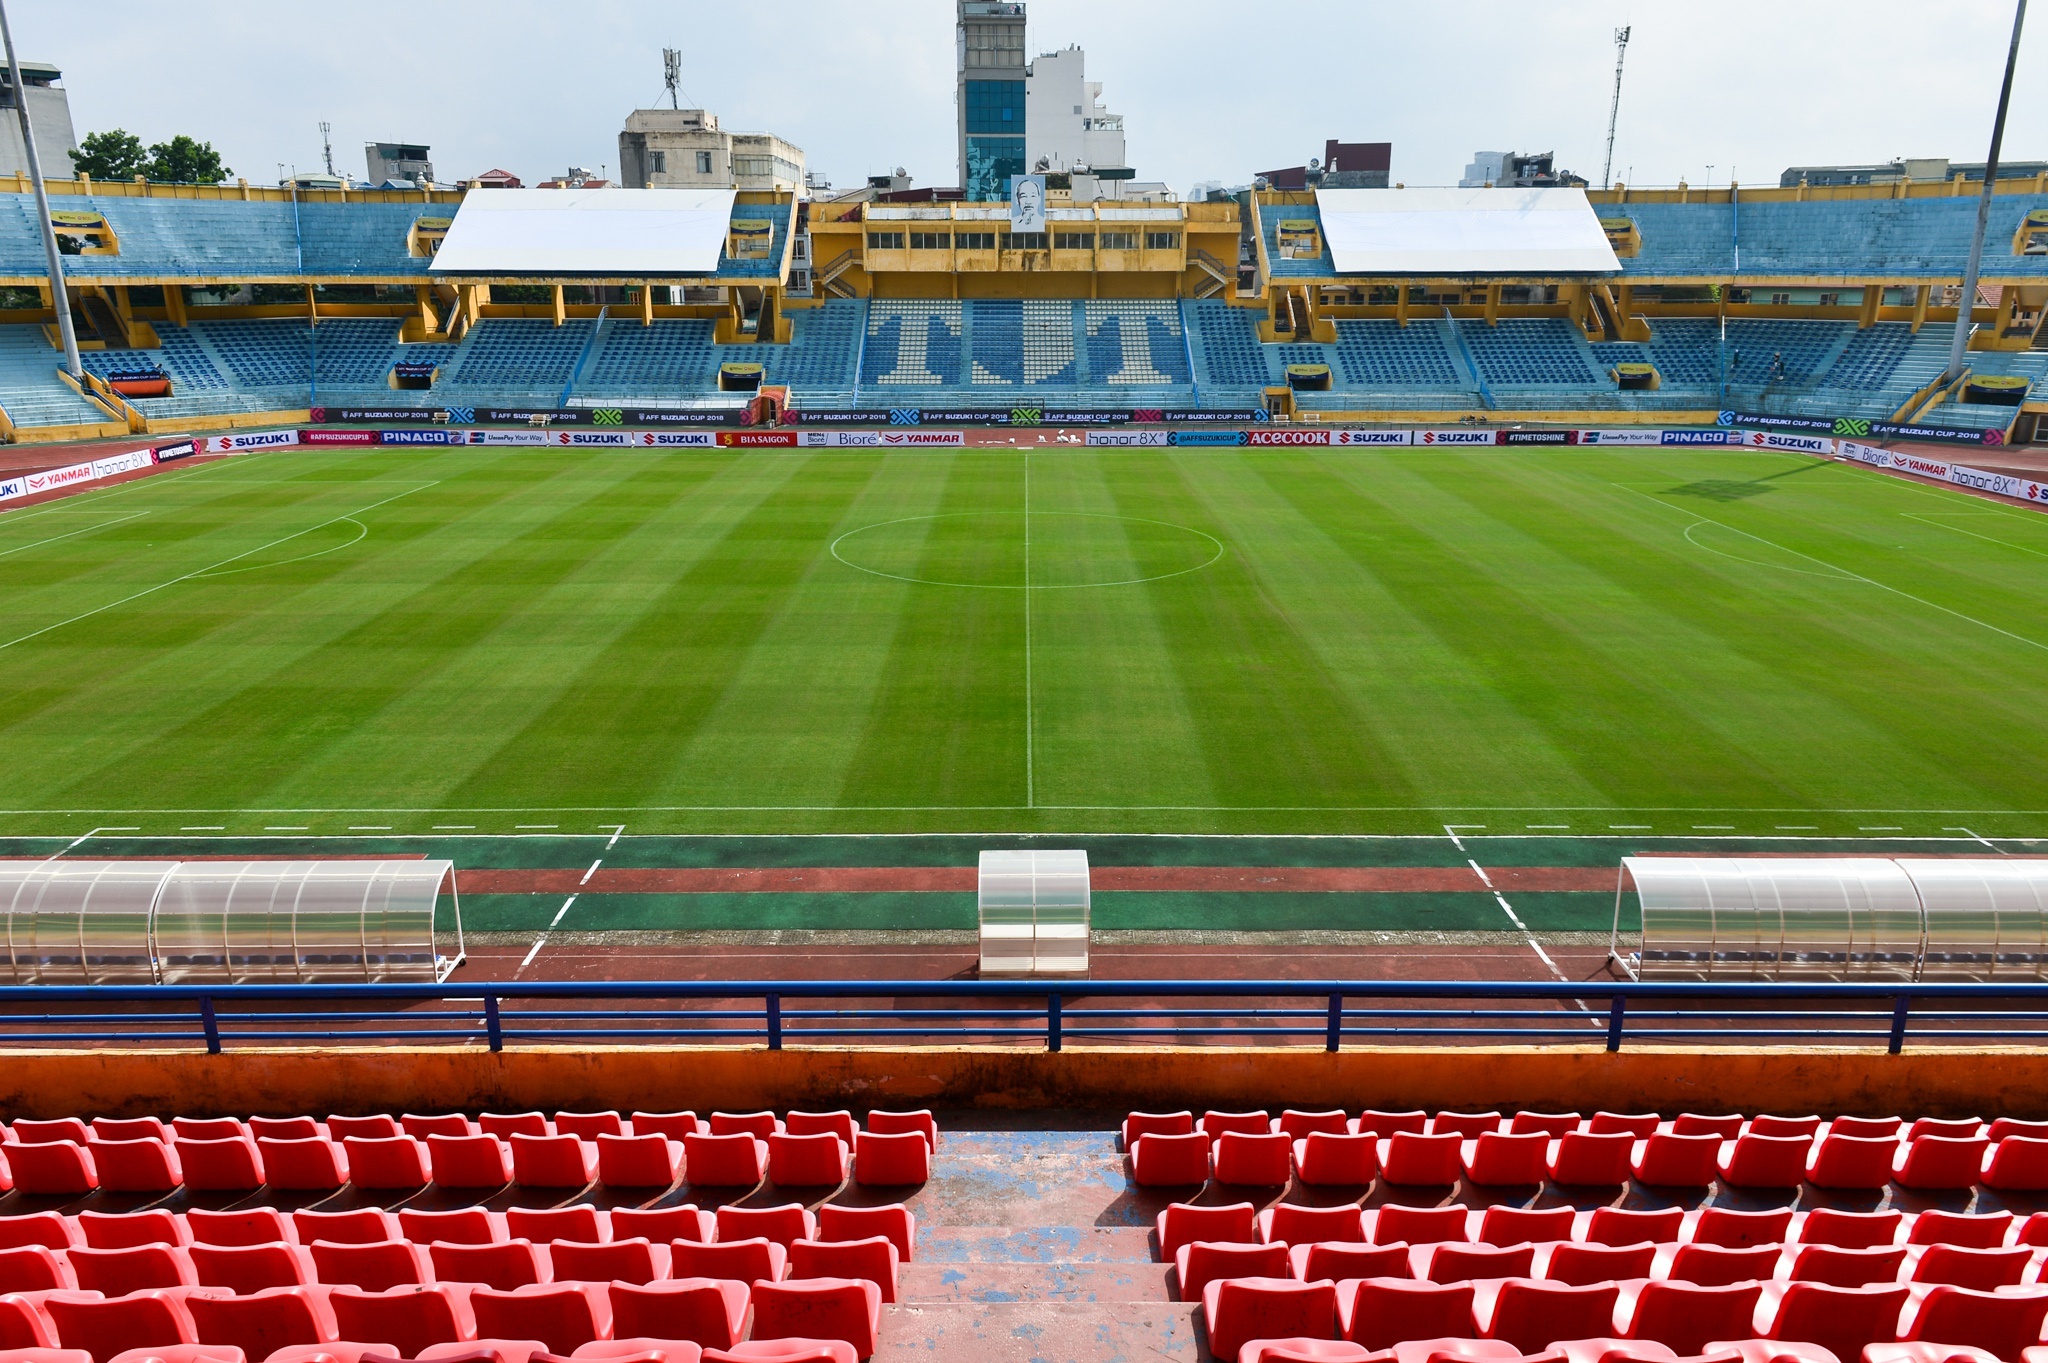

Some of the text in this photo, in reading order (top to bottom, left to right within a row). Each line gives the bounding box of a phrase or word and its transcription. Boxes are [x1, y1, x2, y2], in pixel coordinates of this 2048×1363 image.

[236, 434, 290, 446] SUZUKI
[383, 433, 444, 442] PINACO
[488, 434, 514, 442] UnionPay
[531, 434, 543, 442] Way
[574, 435, 623, 443] SUZUKI
[658, 435, 708, 443] SUZUKI
[839, 433, 876, 444] Bioré
[907, 434, 959, 442] YANMAR
[1089, 433, 1158, 444] honor 8X
[1179, 435, 1236, 443] @AFFSUZUKICUP
[1353, 434, 1403, 442] SUZUKI
[1438, 434, 1488, 442] SUZUKI
[1509, 433, 1565, 442] #TIMETOSHINE
[1602, 434, 1628, 442] UnionPay
[1664, 432, 1724, 442] PINACO
[1768, 436, 1822, 450] SUZUKI
[1862, 447, 1888, 465] Bioré
[97, 454, 146, 476] honor 8X
[1908, 459, 1946, 476] YANMAR
[47, 467, 90, 485] YANMAR
[1952, 467, 2011, 493] honor 8X
